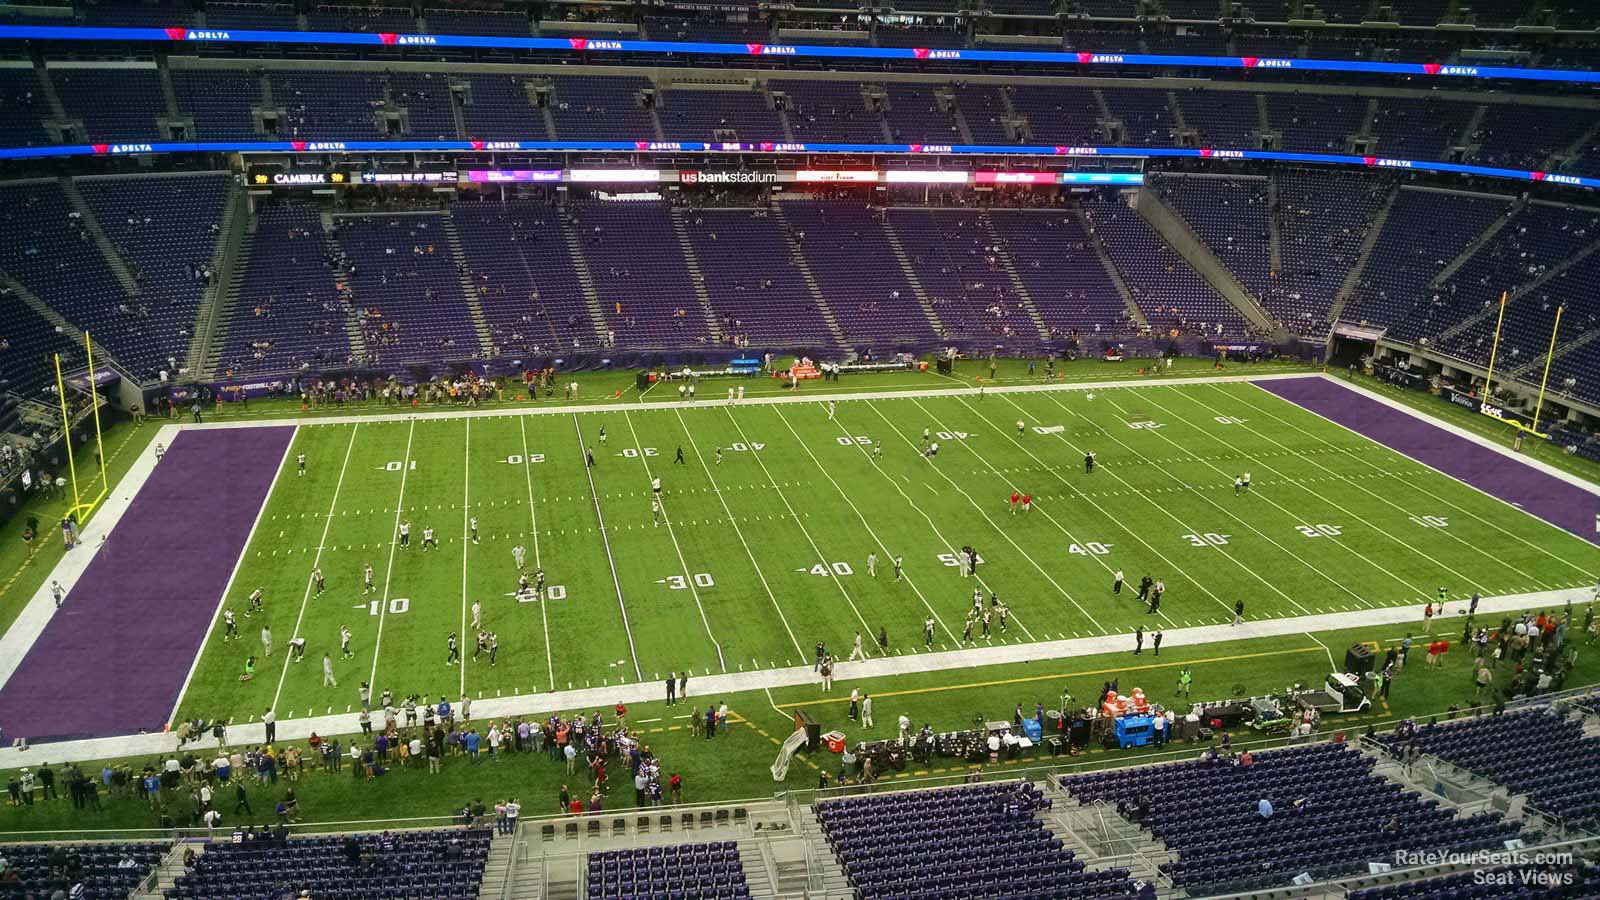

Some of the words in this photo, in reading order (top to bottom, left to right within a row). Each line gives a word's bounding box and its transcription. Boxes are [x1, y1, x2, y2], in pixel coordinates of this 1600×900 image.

[198, 31, 229, 39] DELTA
[408, 36, 436, 44] DELTA
[1386, 159, 1411, 167] DELTA
[273, 173, 325, 183] CAMBRIA
[1554, 176, 1580, 184] DELTA
[1408, 515, 1448, 527] 10
[1295, 524, 1342, 537] 20
[1181, 533, 1229, 547] 30
[1068, 542, 1110, 556] 40
[810, 562, 854, 576] 40
[666, 573, 714, 589] 30
[369, 598, 410, 616] 10
